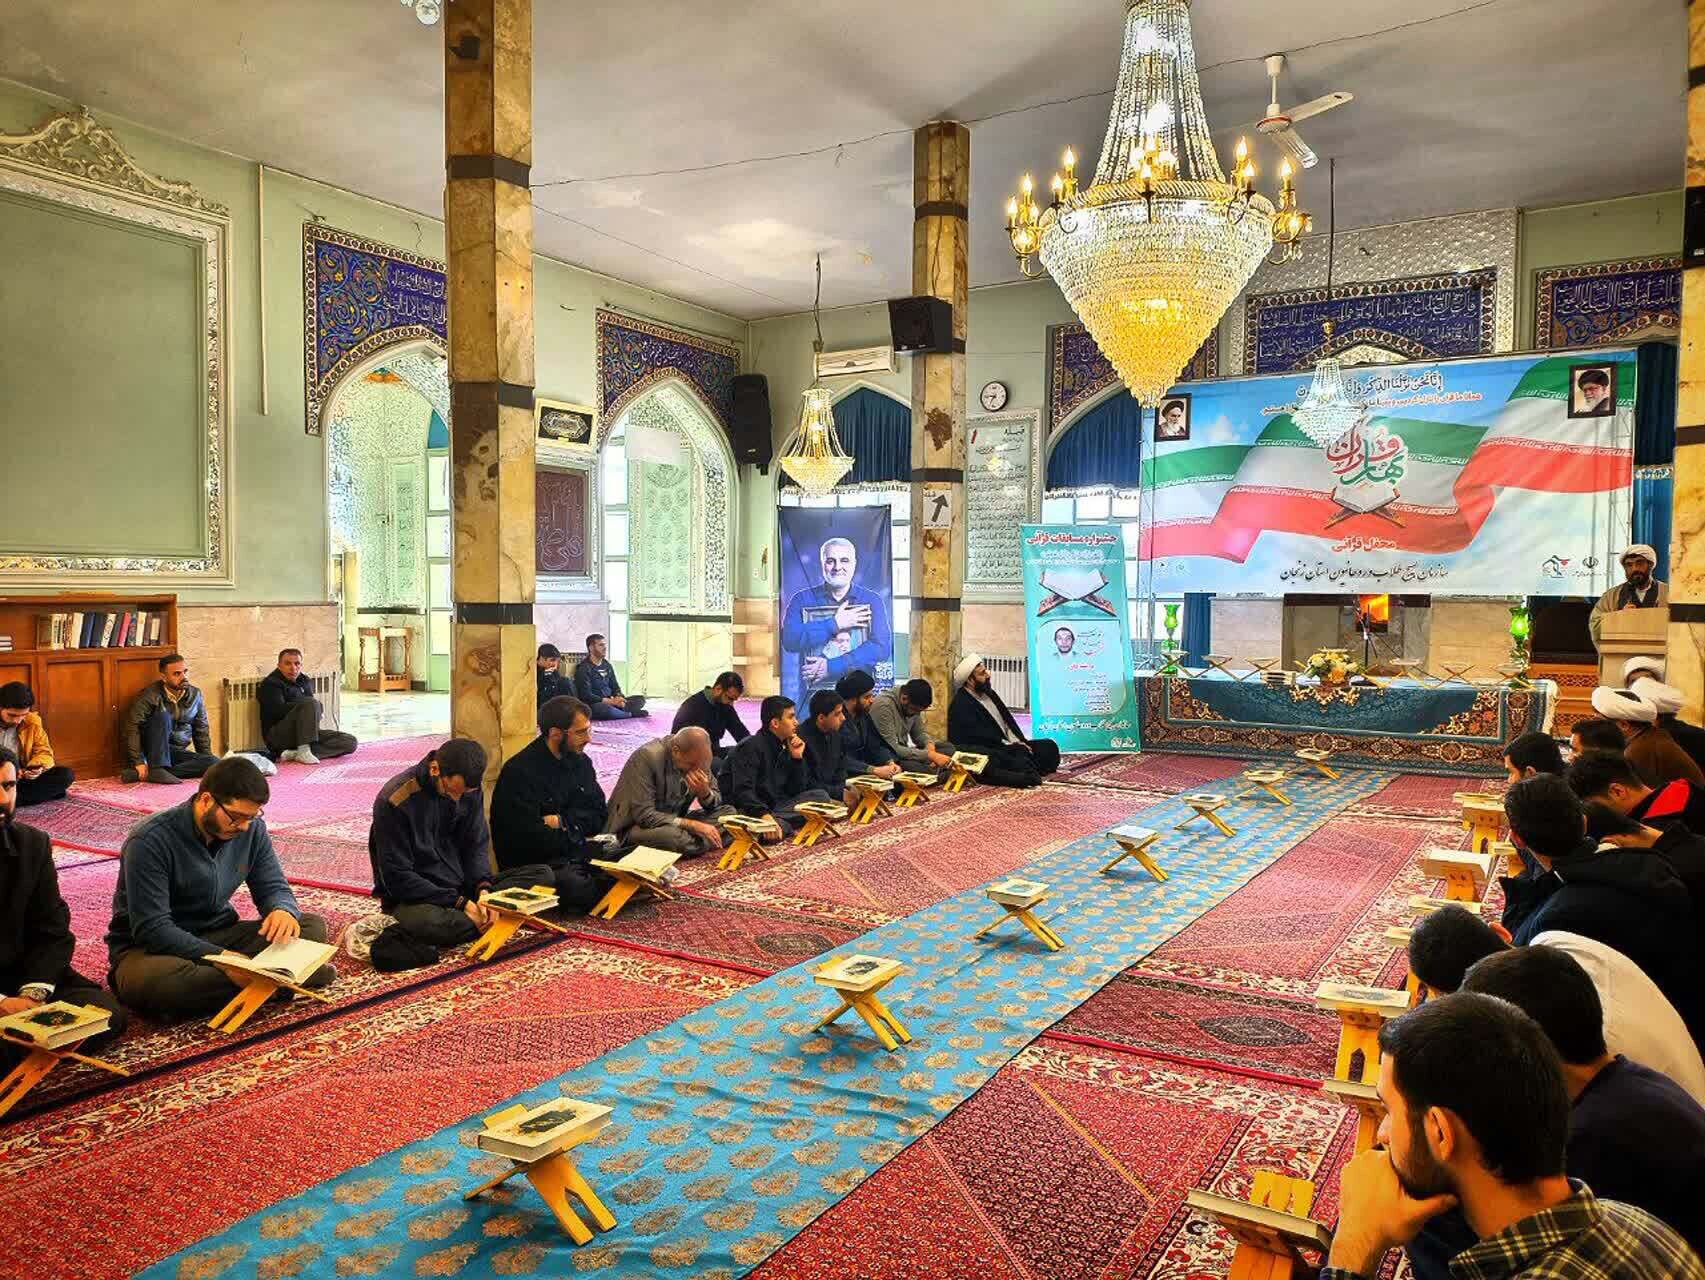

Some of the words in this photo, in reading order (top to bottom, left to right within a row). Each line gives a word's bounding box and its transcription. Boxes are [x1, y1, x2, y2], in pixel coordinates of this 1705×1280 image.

[1339, 438, 1404, 486] بهار
[1331, 535, 1362, 553] قرآنی
[1363, 536, 1396, 552] محفل
[1279, 559, 1306, 585] زنجان
[1305, 561, 1329, 581] استان
[1328, 559, 1367, 586] روحانیون
[1371, 563, 1401, 583] طلاب
[1416, 562, 1449, 581] سازمان
